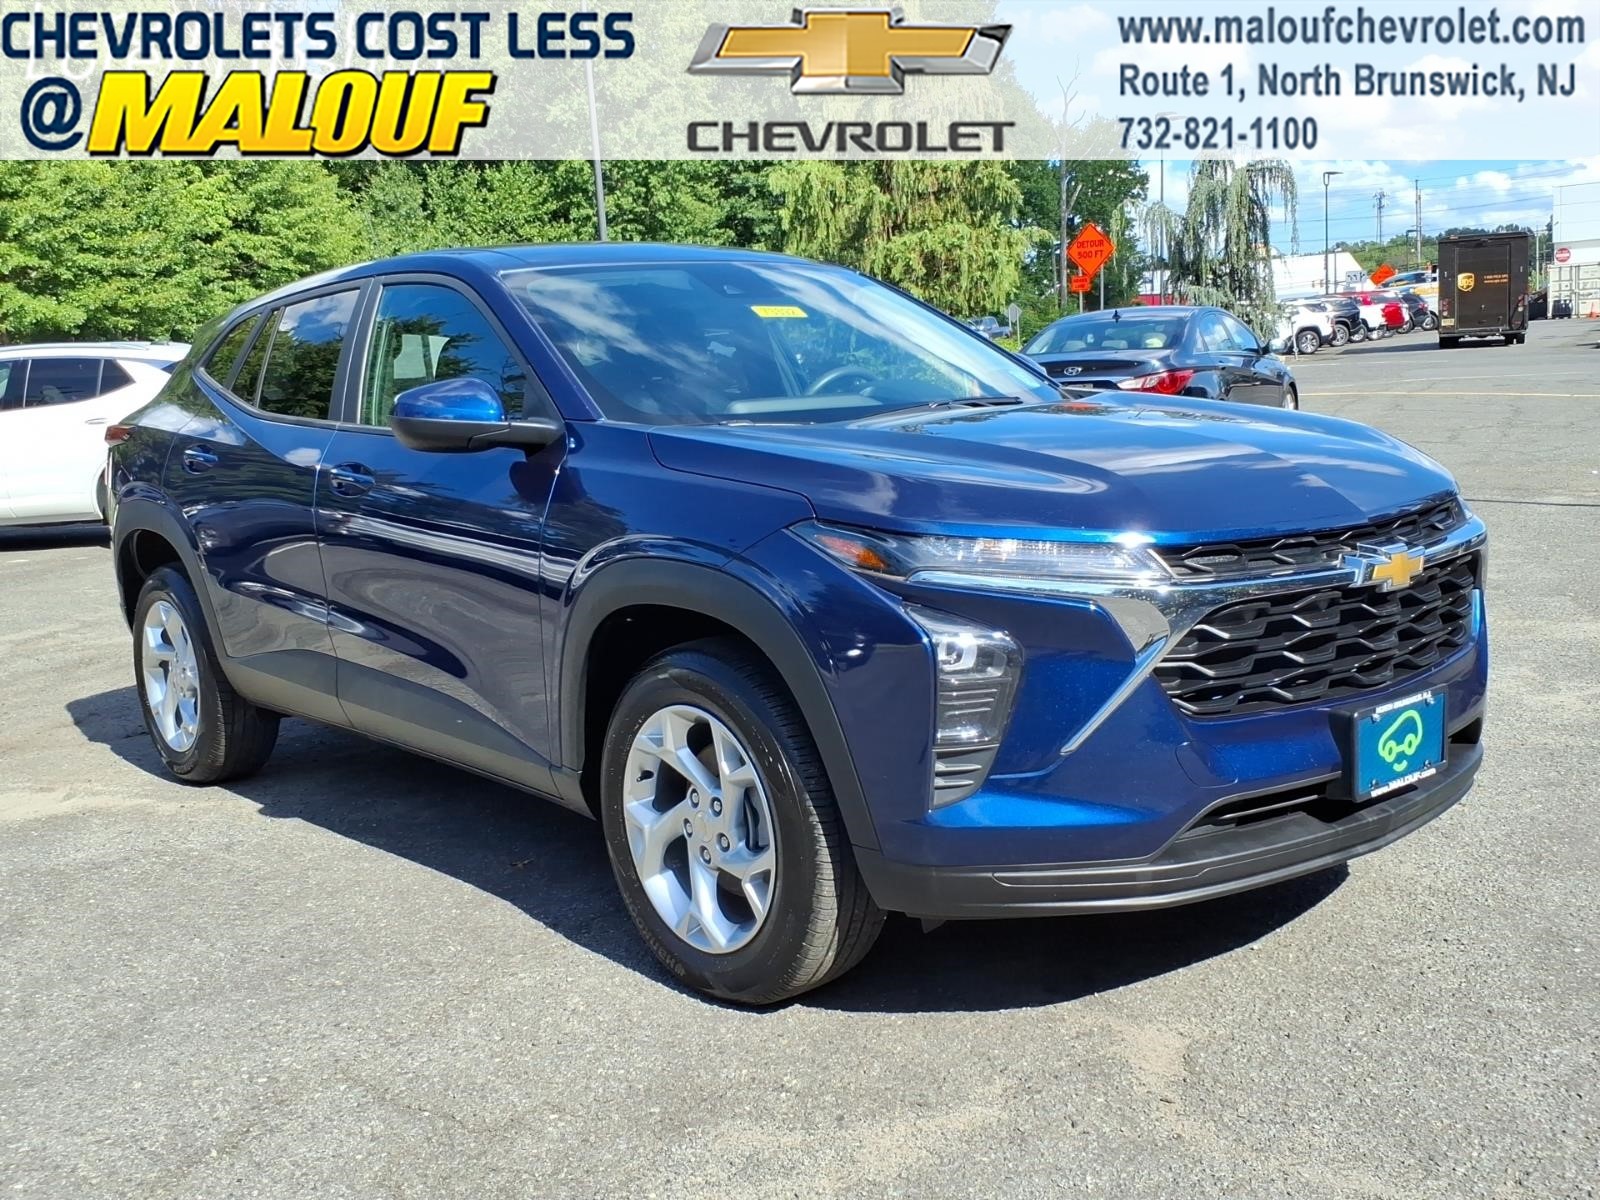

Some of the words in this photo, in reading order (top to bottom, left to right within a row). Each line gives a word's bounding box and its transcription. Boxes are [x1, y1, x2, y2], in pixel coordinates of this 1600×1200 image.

[1076, 239, 1105, 249] DETOUR
[1077, 250, 1093, 259] 500
[1094, 249, 1104, 259] FT
